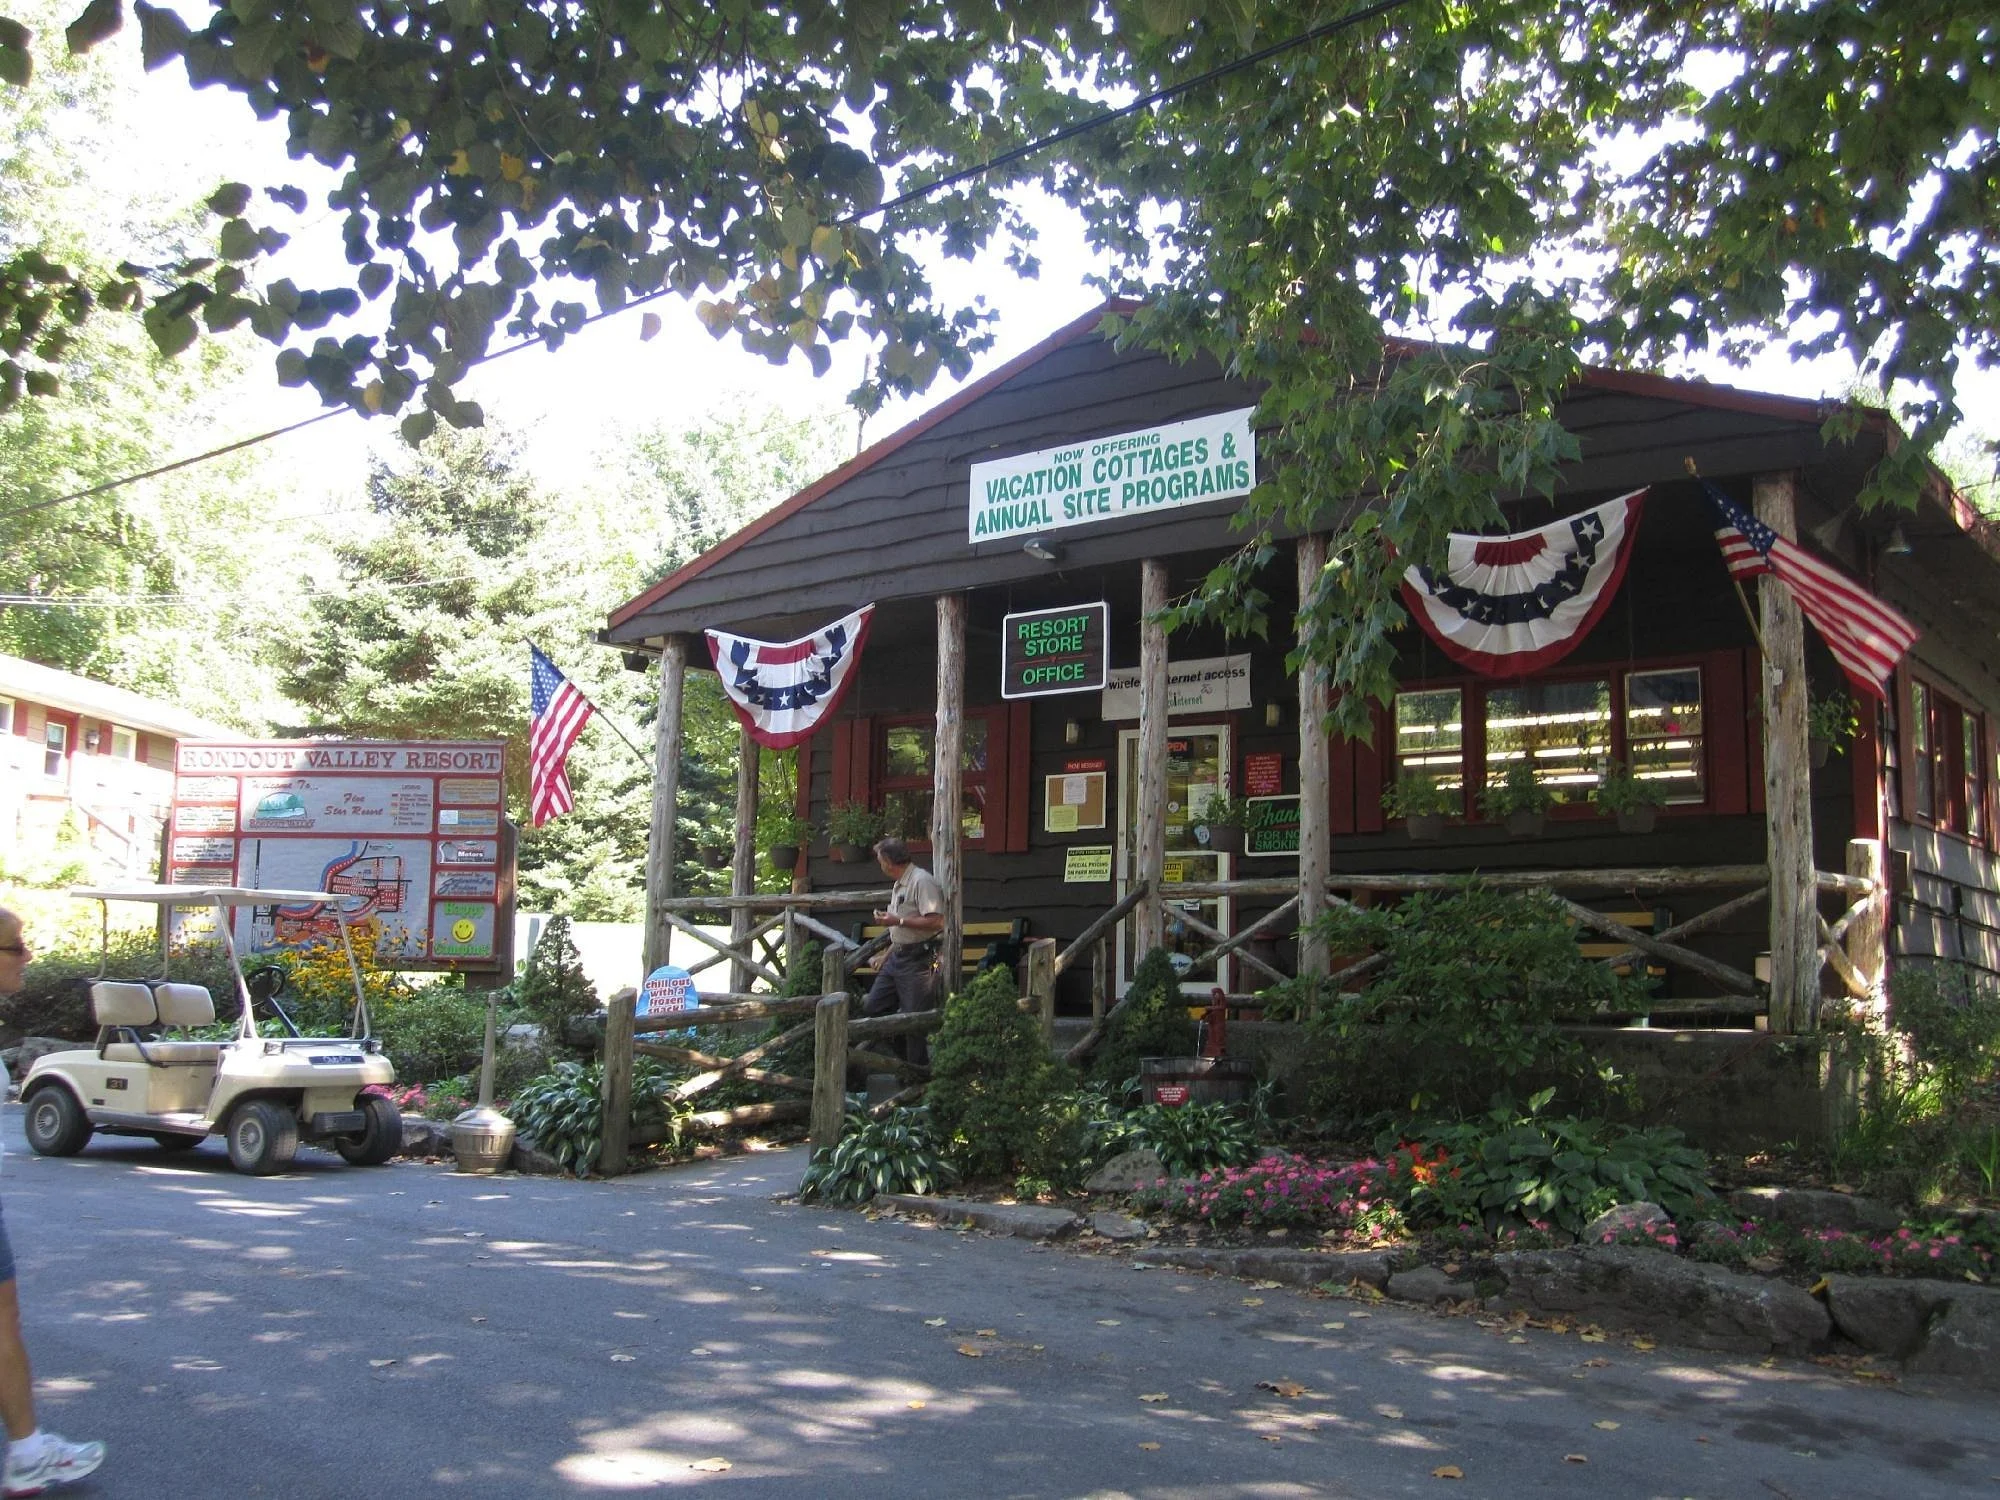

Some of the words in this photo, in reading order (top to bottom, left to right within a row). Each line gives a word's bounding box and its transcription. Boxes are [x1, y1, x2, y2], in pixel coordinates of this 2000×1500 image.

[1053, 448, 1085, 464] NOW
[1091, 433, 1161, 457] OFFERING
[986, 464, 1082, 504] VACATION
[1093, 437, 1208, 484] COTTAGES
[1221, 432, 1237, 459] &
[975, 499, 1053, 536] ANNUAL
[1064, 488, 1110, 520] SITE
[1122, 460, 1250, 509] PROGRAMS
[1018, 616, 1089, 639] RESORT
[1024, 635, 1083, 657] STORE
[1022, 664, 1085, 685] OFFICE
[1108, 676, 1141, 690] wirele
[1168, 671, 1202, 684] ternet
[1204, 667, 1246, 681] access
[1167, 741, 1188, 752] PEN
[183, 751, 295, 769] RONDOUT
[305, 751, 396, 768] VALLEY
[406, 751, 499, 769] RESORT
[343, 792, 366, 804] Five
[324, 805, 346, 815] Star
[351, 806, 384, 816] Resort
[1257, 830, 1280, 840] FOR
[1255, 840, 1300, 850] SMOKIN
[646, 979, 668, 989] chill
[671, 978, 691, 987] out
[650, 988, 674, 997] with
[650, 997, 684, 1006] frozen
